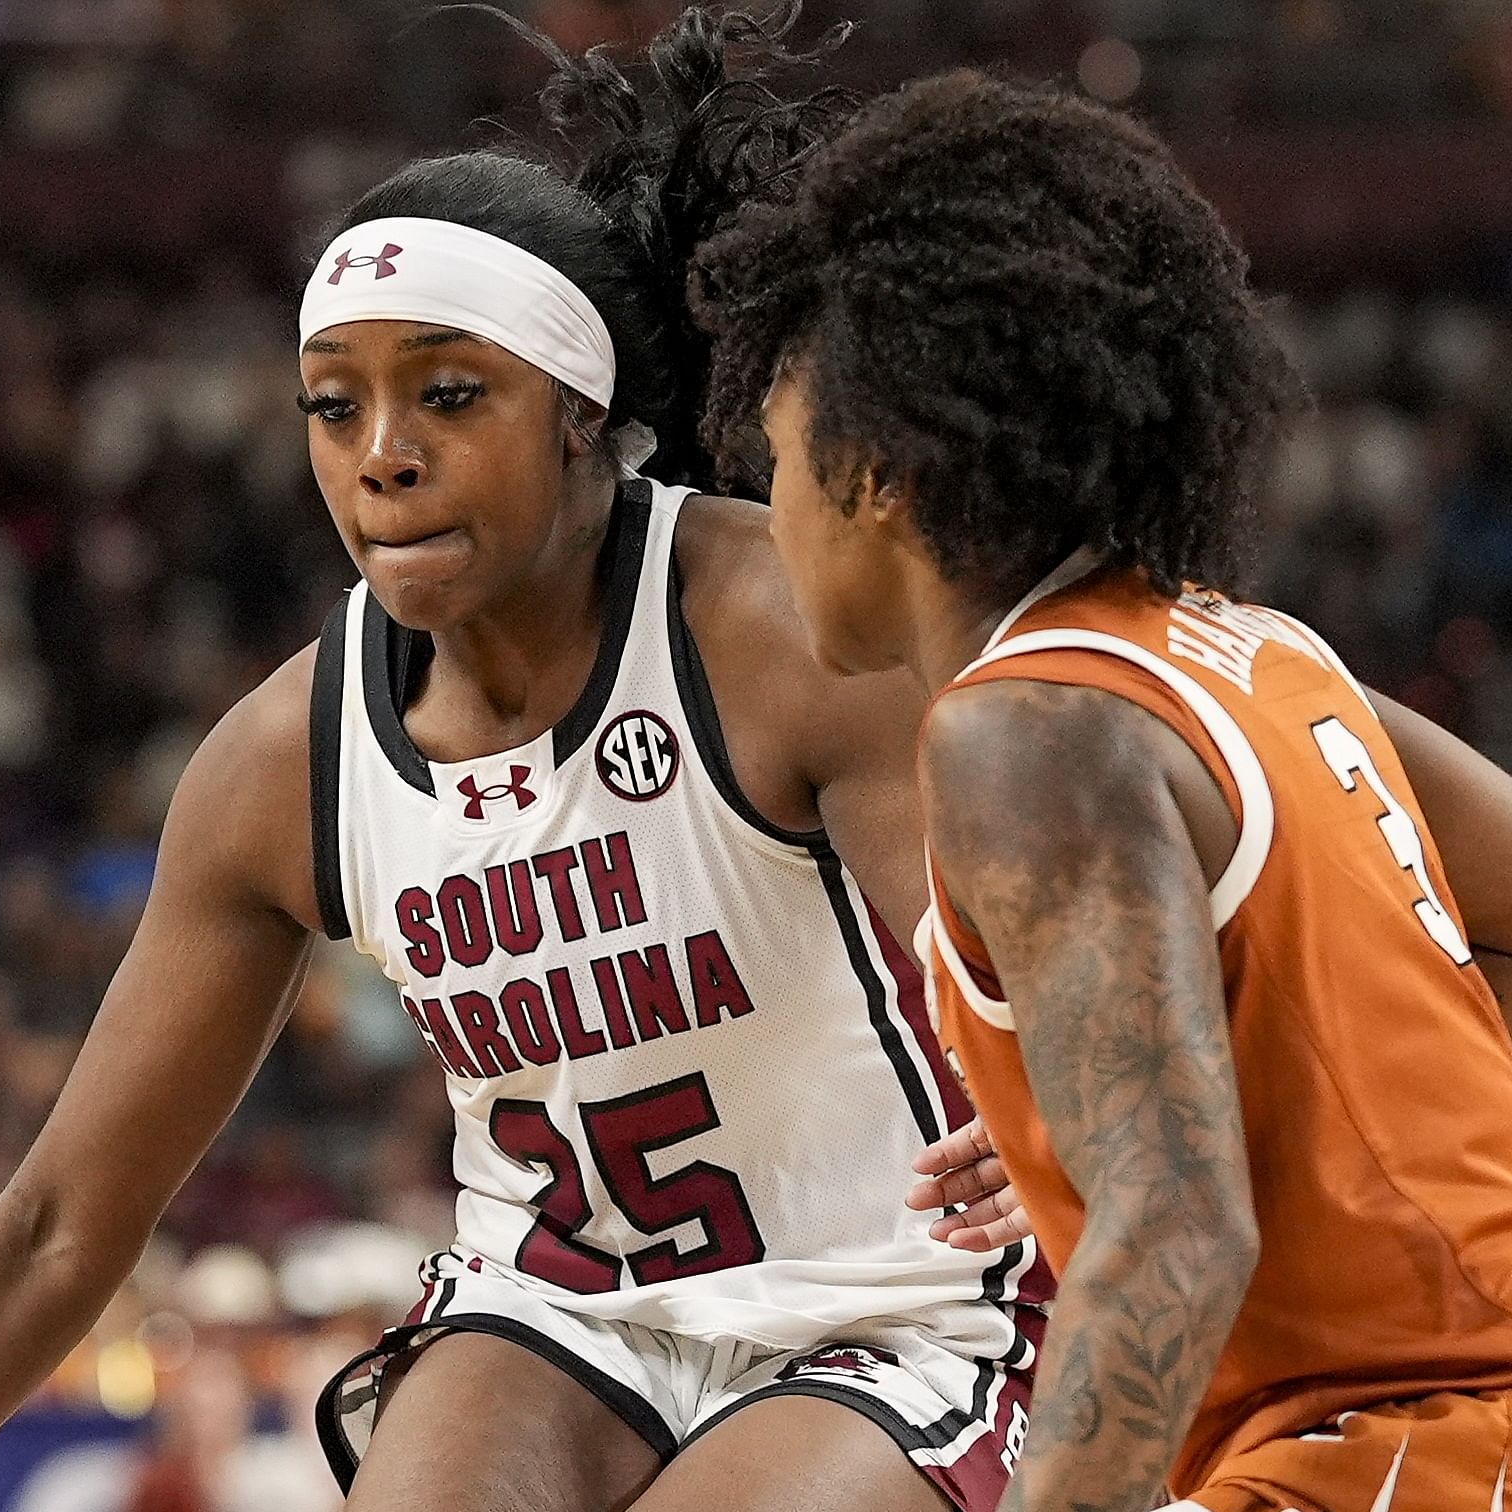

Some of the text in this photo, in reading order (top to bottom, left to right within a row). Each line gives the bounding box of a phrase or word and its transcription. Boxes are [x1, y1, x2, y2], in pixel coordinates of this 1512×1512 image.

[601, 716, 673, 796] SEC
[1310, 714, 1473, 966] 3
[395, 830, 649, 979] SOUTH
[488, 1069, 768, 1297] 25
